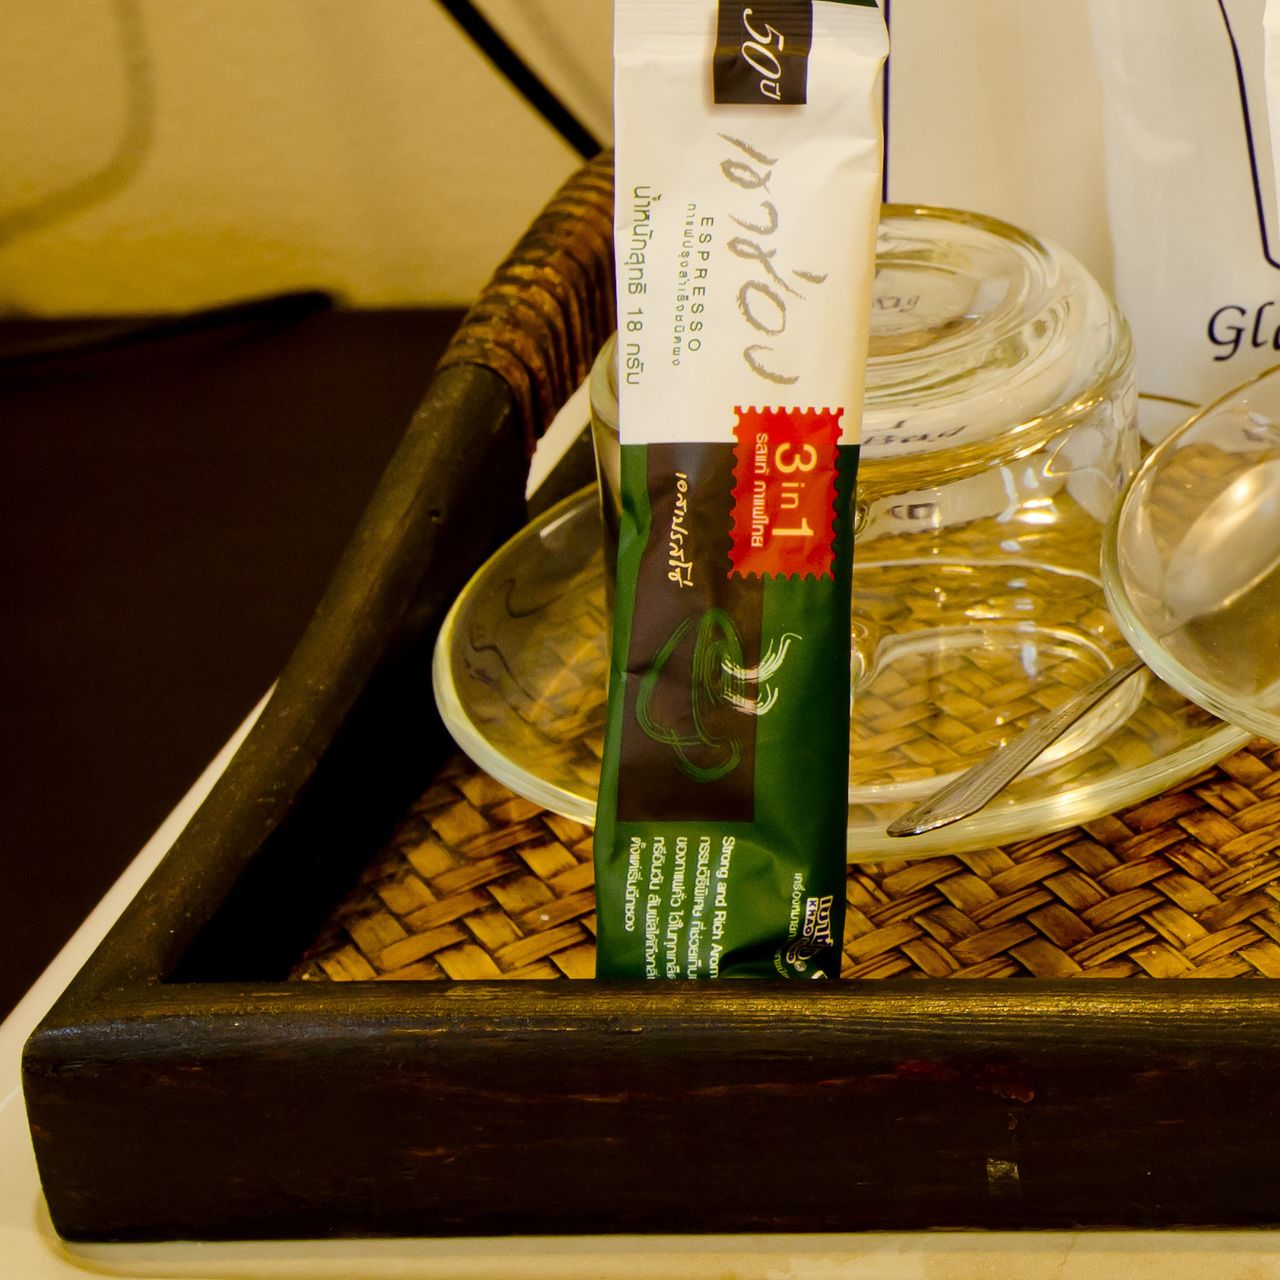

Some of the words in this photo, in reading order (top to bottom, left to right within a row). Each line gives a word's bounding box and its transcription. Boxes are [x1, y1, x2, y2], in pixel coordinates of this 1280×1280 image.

[623, 185, 662, 295] น้ำหนักสุทธิ
[716, 131, 829, 385] เขาช่อง
[688, 216, 714, 352] ESPRESSO
[626, 307, 644, 332] 18
[625, 343, 645, 386] กรัม
[753, 432, 770, 475] รสแท้
[775, 443, 818, 474] 3
[750, 479, 770, 548] กาแฟไทย
[780, 481, 806, 510] in
[771, 517, 815, 537] 1
[717, 836, 736, 879] Strong
[715, 881, 730, 907] and
[712, 910, 728, 941] Rich
